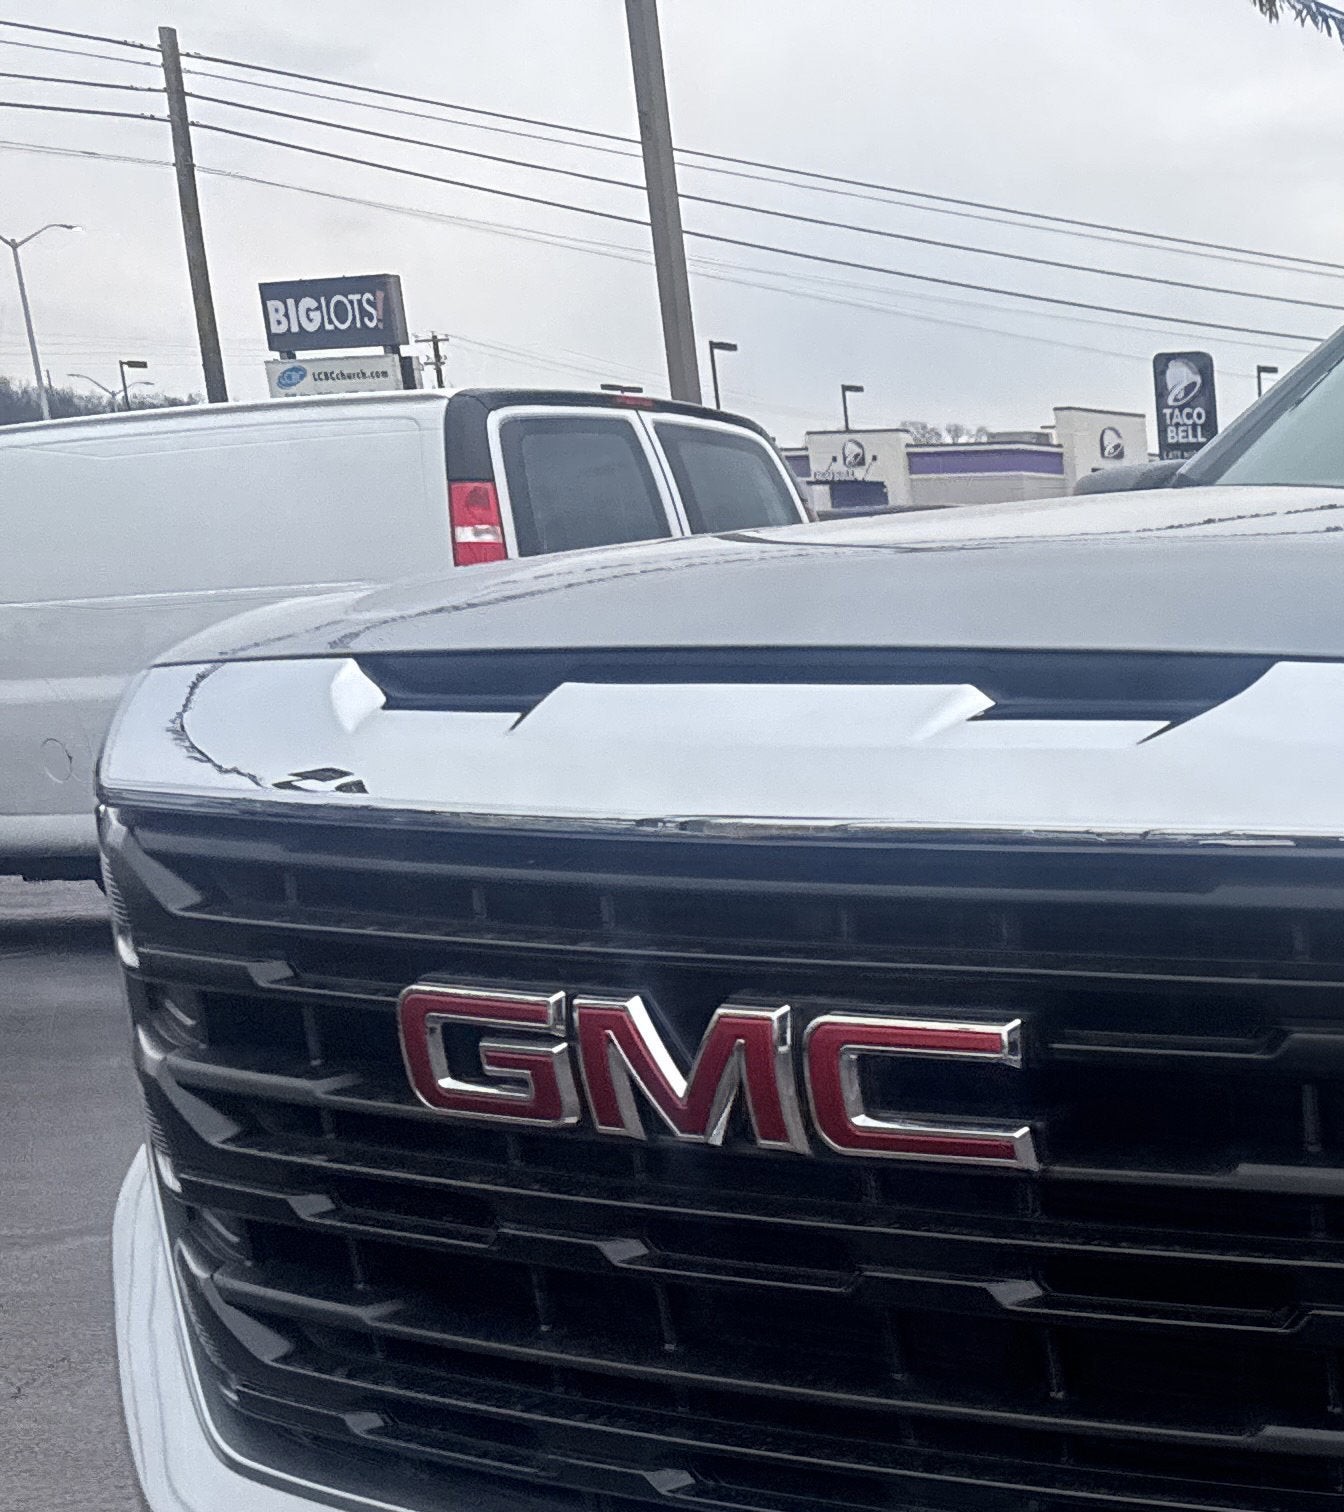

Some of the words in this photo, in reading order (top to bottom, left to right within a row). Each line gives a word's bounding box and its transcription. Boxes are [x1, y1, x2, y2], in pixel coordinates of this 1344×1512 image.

[1163, 407, 1206, 425] TACO
[1167, 425, 1207, 443] BELL
[399, 984, 1038, 1170] GMC
